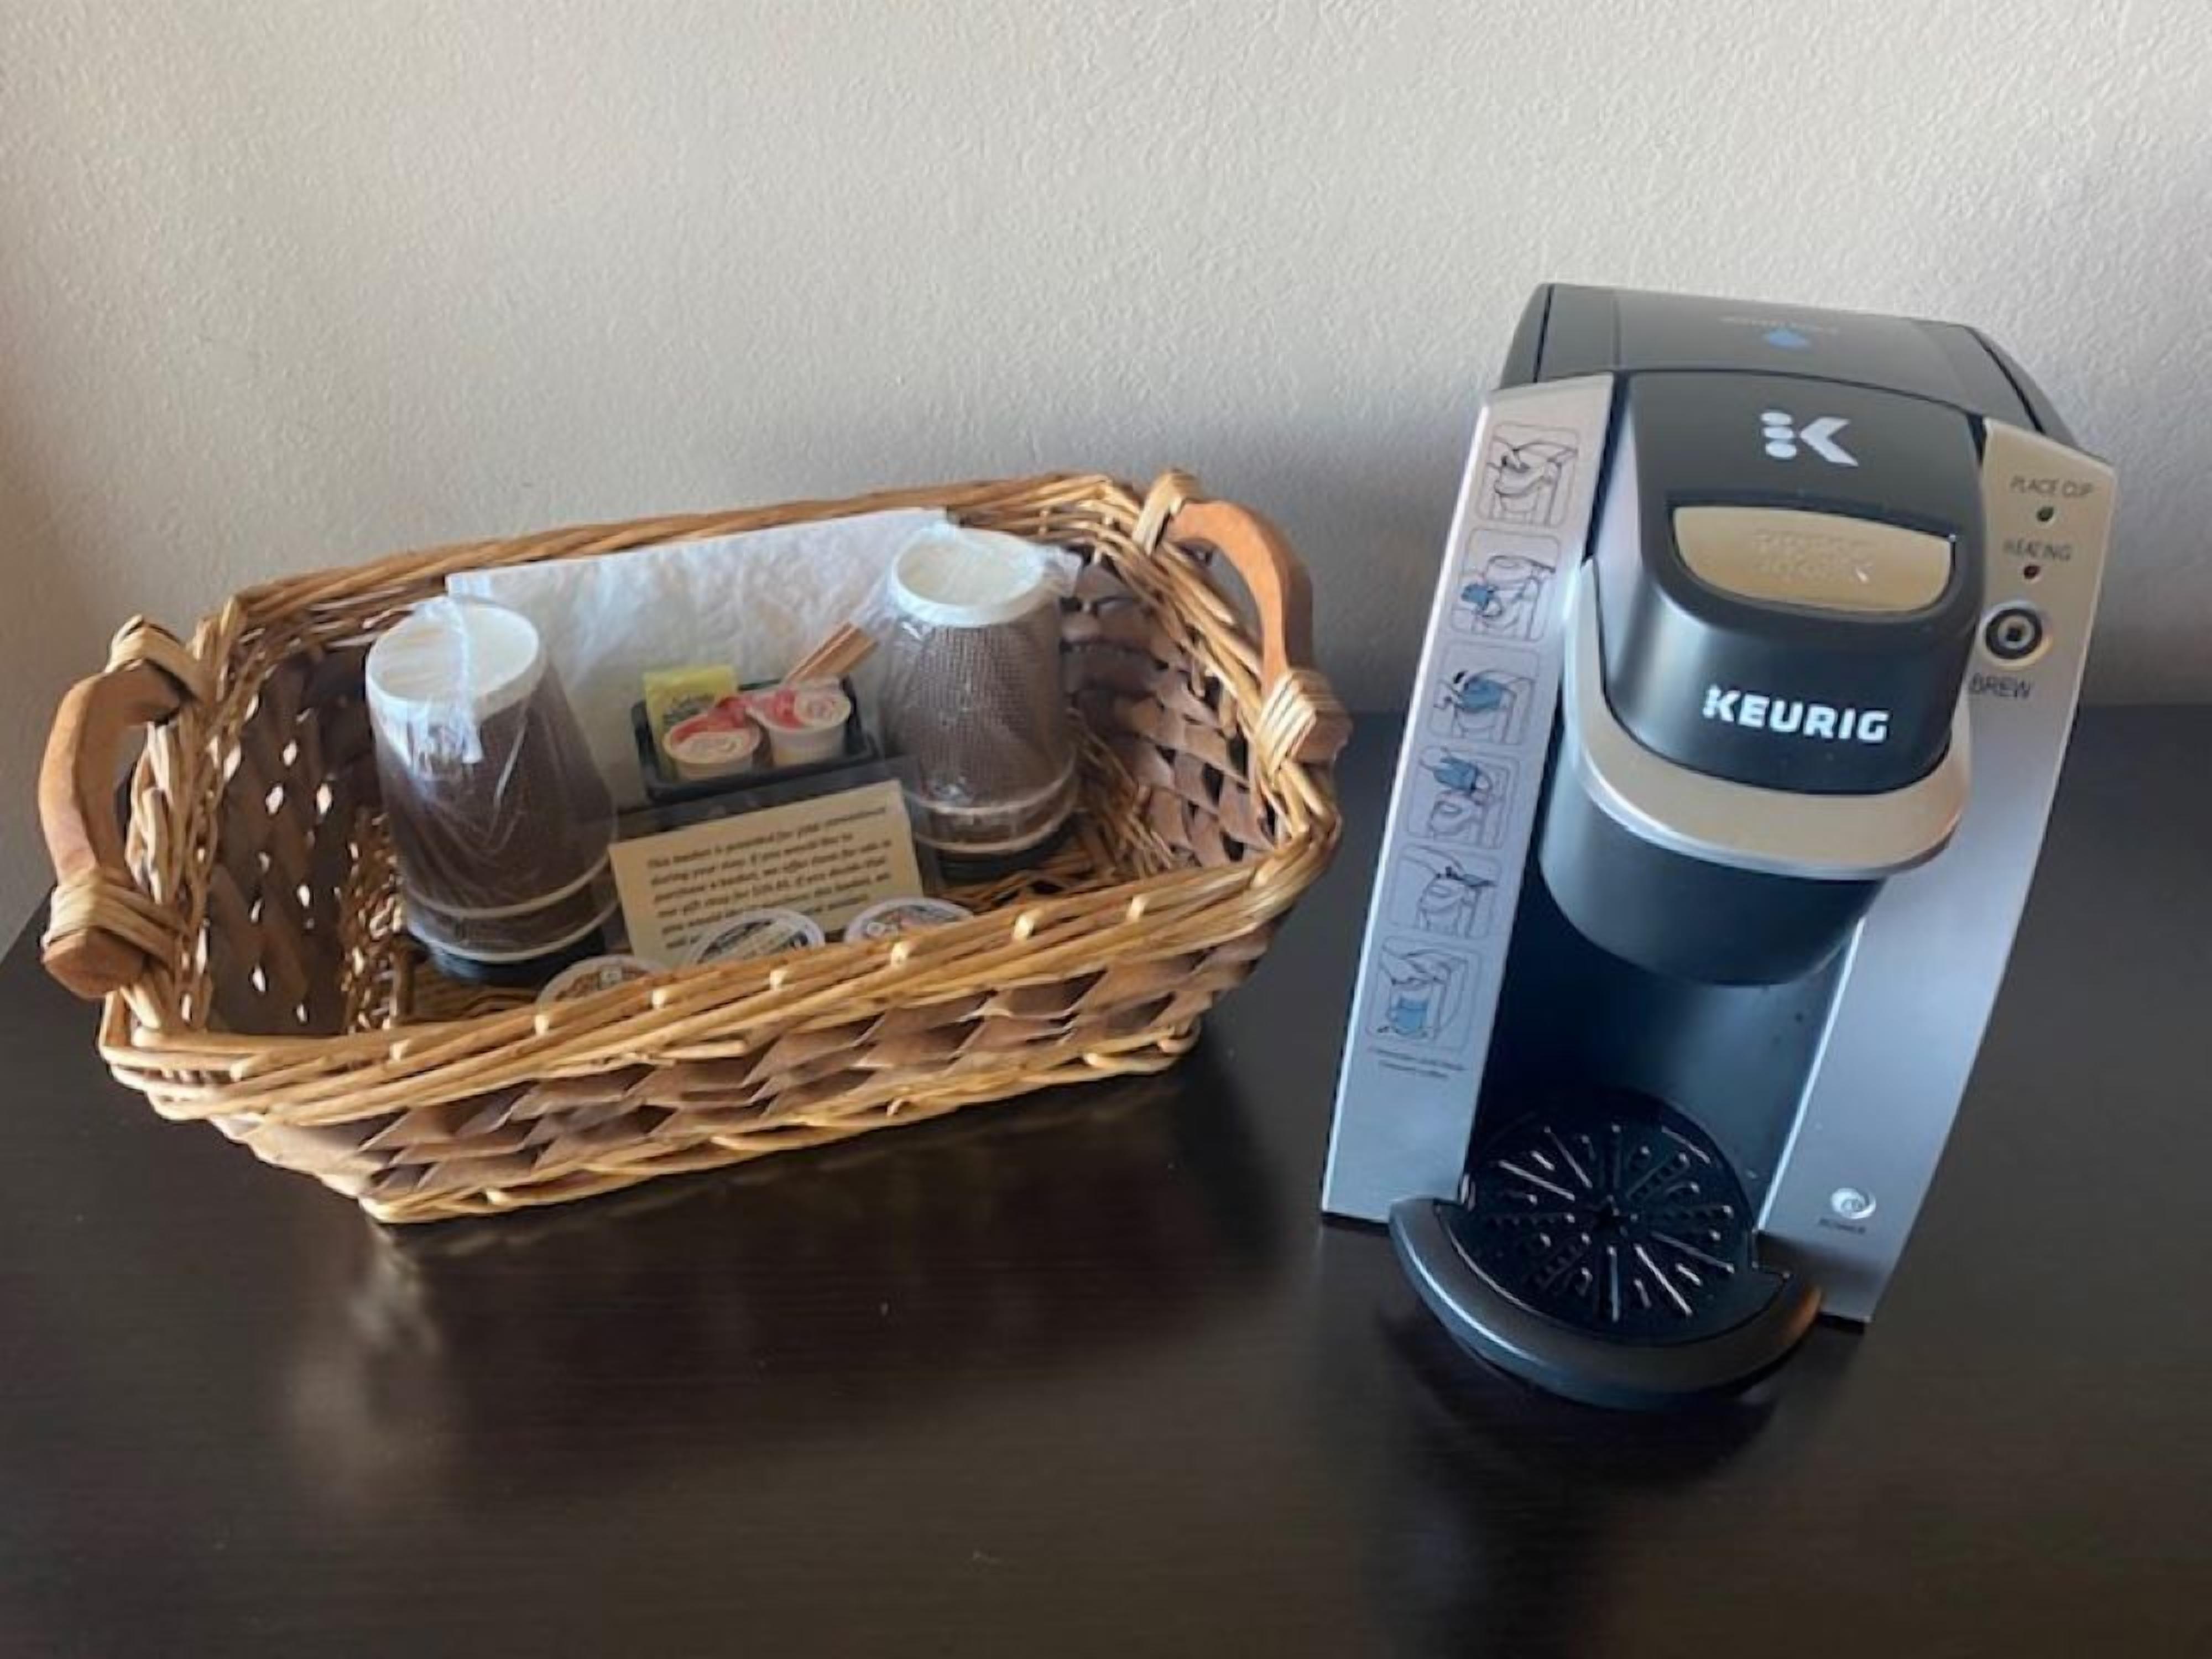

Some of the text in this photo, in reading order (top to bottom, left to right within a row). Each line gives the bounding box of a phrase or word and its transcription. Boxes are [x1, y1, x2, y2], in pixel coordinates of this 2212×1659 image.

[2010, 476, 2094, 497] PLACE CUP
[1969, 674, 2034, 698] BREW
[1703, 684, 1889, 742] KEURIG
